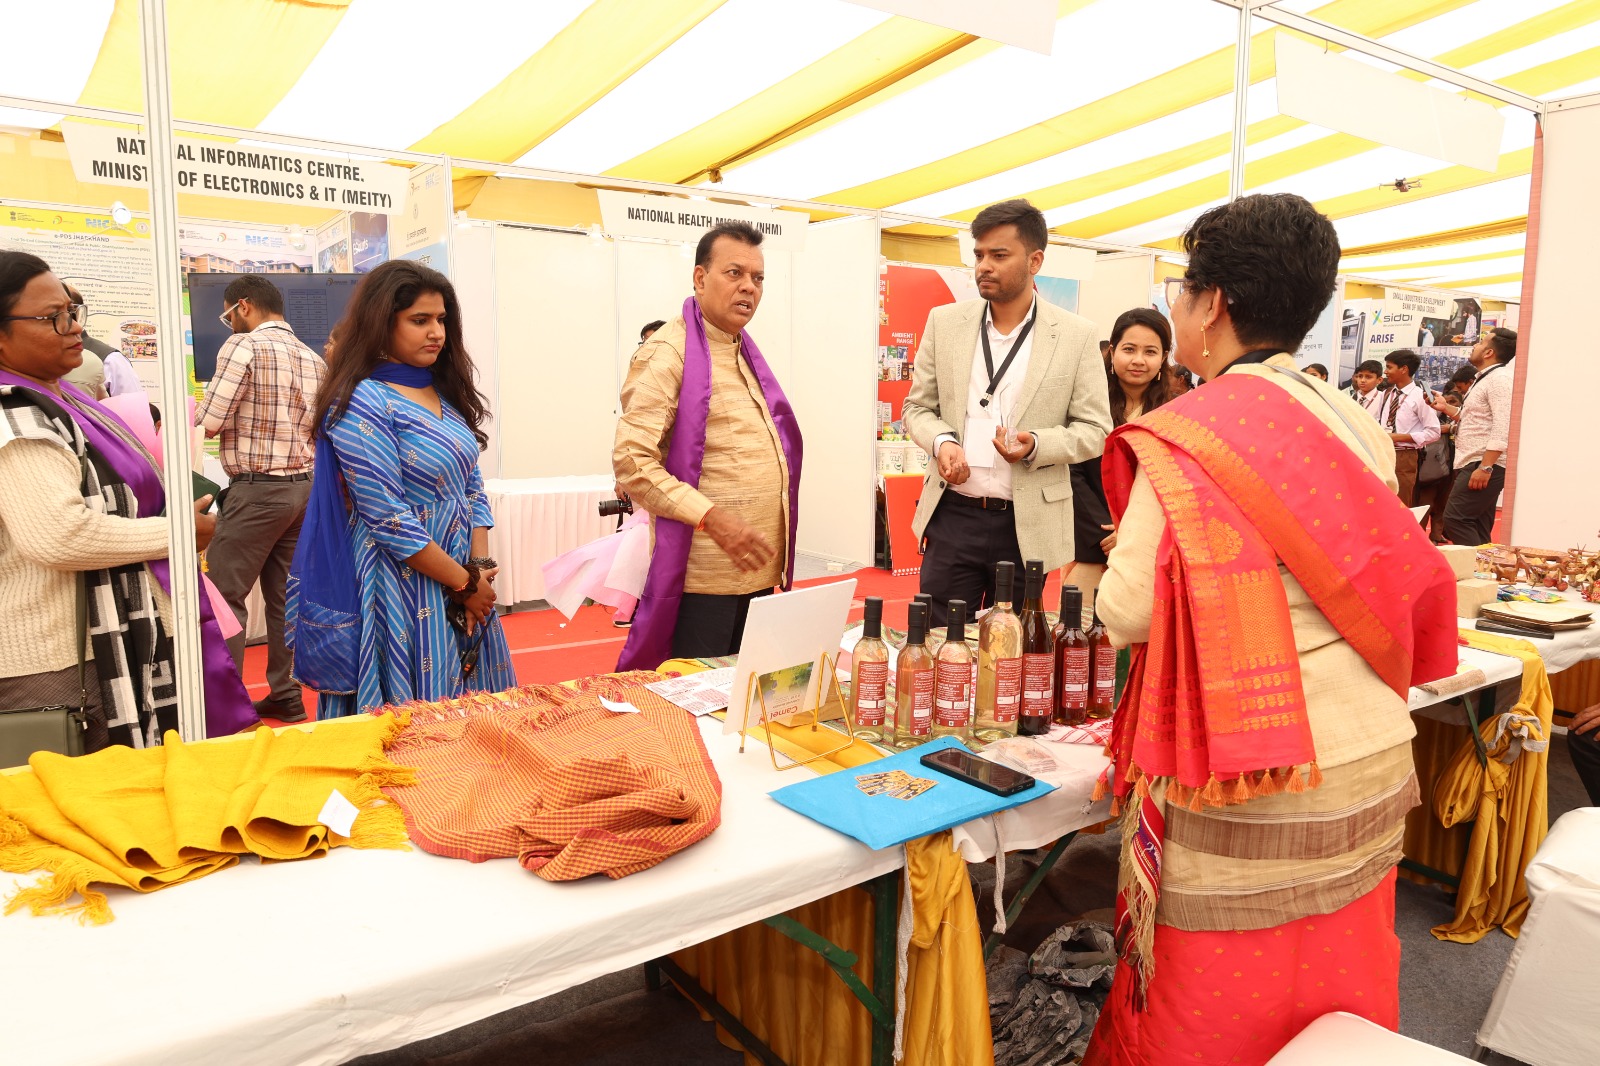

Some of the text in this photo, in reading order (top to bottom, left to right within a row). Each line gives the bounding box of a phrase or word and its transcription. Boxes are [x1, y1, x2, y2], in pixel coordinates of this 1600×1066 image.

[117, 136, 365, 183] NATAL INFORMATICS CENTRE.
[177, 170, 198, 187] OF
[203, 173, 304, 199] ELECTRONICS
[309, 185, 319, 200] &
[324, 187, 337, 202] IT
[342, 189, 392, 208] (MEITY)
[627, 206, 675, 224] NATIONAL
[678, 212, 712, 228] HEALTH
[1383, 313, 1413, 323] sidbi
[1369, 333, 1395, 344] ARISE
[770, 705, 798, 720] Camel
